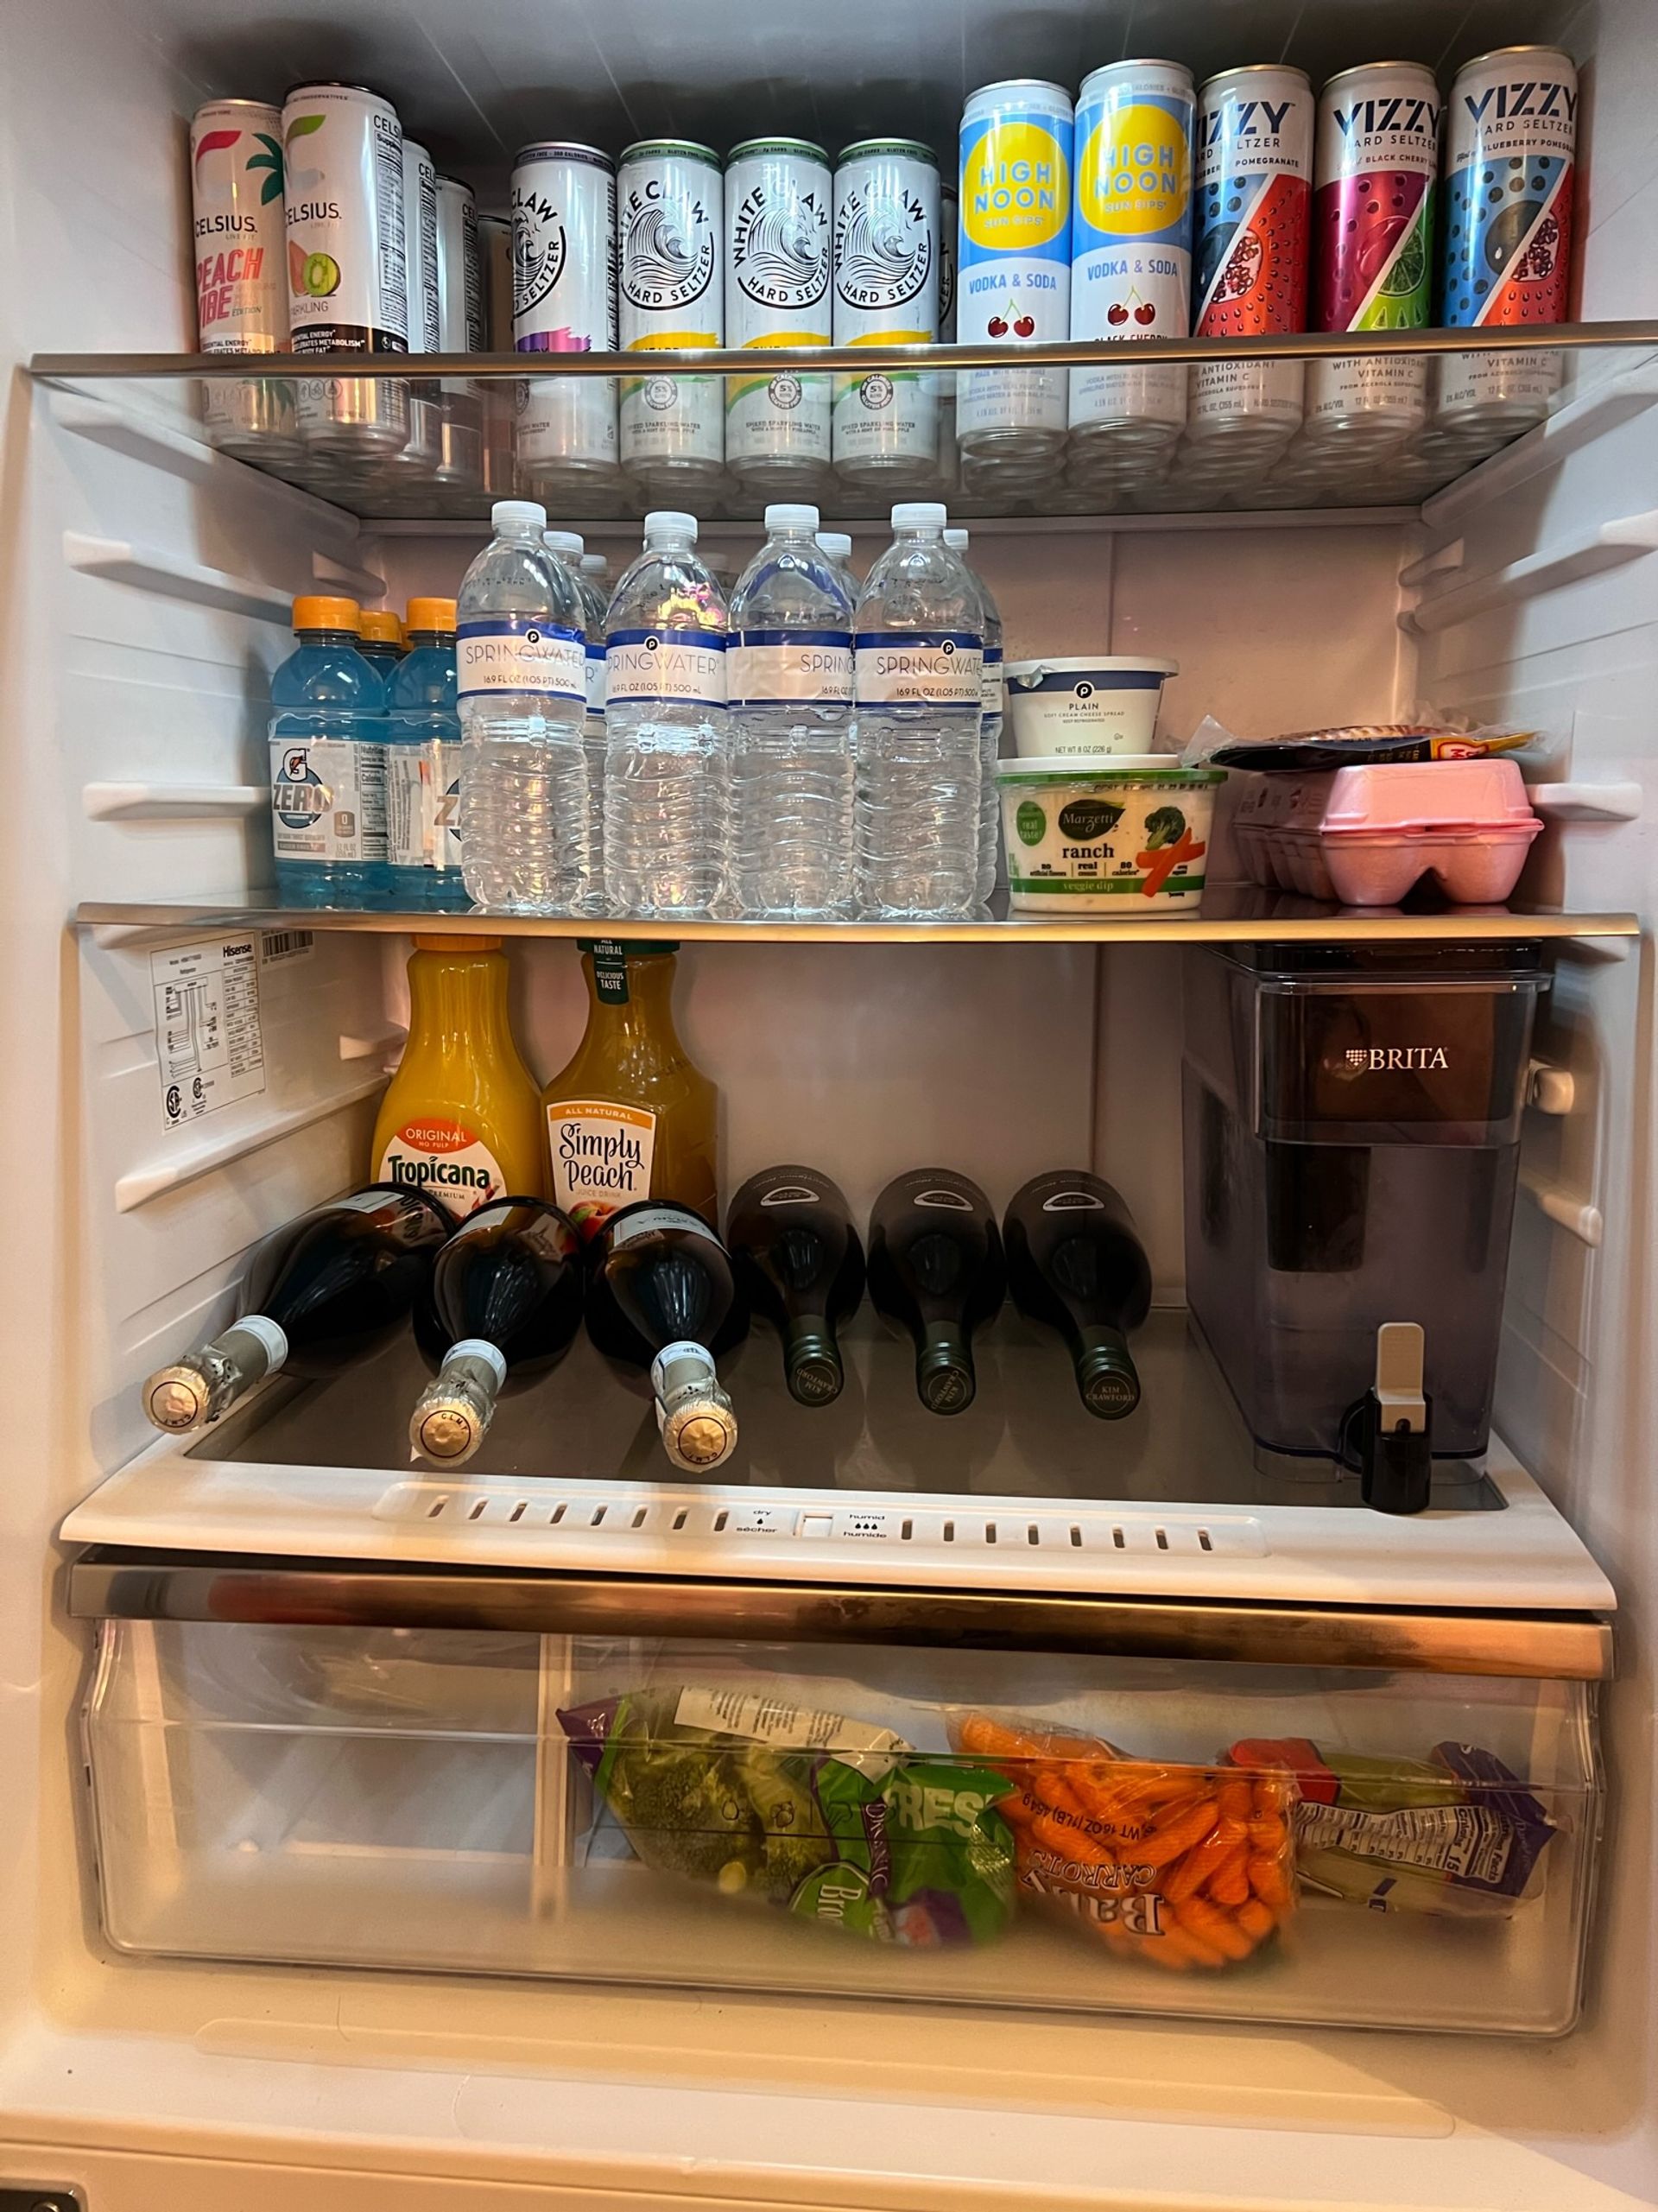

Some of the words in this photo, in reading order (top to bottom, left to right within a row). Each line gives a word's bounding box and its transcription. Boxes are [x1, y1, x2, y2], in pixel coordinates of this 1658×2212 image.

[1465, 82, 1577, 124] VIZZY
[1333, 98, 1440, 136] VIZZY
[1353, 135, 1383, 149] ARD
[1102, 143, 1174, 168] HIGH
[1235, 157, 1299, 168] POMEGRANATE
[1365, 154, 1396, 162] BLACK
[1399, 154, 1427, 163] CHERRY
[980, 162, 1052, 188] HIGH
[1094, 169, 1177, 198] NOON
[974, 187, 1055, 216] NOON
[733, 187, 766, 269] WHITE
[834, 190, 861, 275] WHITE
[522, 239, 560, 305] SELTZER
[627, 282, 663, 304] HARD
[670, 244, 712, 302] SELTZER
[747, 276, 789, 302] HARD
[795, 246, 828, 302] SELTZER
[843, 282, 880, 302] HARD
[887, 241, 927, 301] SELTZER
[1087, 260, 1128, 282] VODKA
[1134, 258, 1142, 274] &
[1149, 258, 1178, 277] SODA
[969, 274, 1007, 295] VODKA
[1012, 274, 1022, 288] &
[1026, 273, 1057, 291] SODA
[1201, 360, 1276, 377] ANTIOXIDANT
[1332, 359, 1362, 371] WITH
[1487, 357, 1537, 367] VITAMIN
[1541, 358, 1547, 366] C
[1196, 373, 1238, 389] VITAMIN
[1242, 372, 1250, 381] C
[1357, 369, 1405, 378] VITAMIN
[1408, 370, 1414, 378] C
[1468, 372, 1488, 381] FROM
[803, 421, 821, 431] WATER
[498, 675, 507, 684] FL
[509, 675, 522, 683] OZ
[555, 677, 571, 688] 500
[629, 682, 639, 691] OZ
[674, 684, 692, 693] 500
[912, 688, 921, 696] FL
[923, 688, 935, 697] OZ
[1068, 702, 1099, 711] PLAIN
[1055, 745, 1066, 754] NET
[1067, 745, 1077, 754] WT
[1082, 745, 1092, 753] OZ
[1062, 813, 1114, 833] Marzetti
[1062, 843, 1115, 859] ranch
[1063, 882, 1092, 891] veggie
[1097, 881, 1114, 891] dip
[222, 943, 252, 958] Hisense
[593, 944, 623, 955] NATURAL
[596, 970, 624, 980] DELICIOUS
[600, 979, 622, 990] TASTE
[1368, 1047, 1449, 1070] BRITA
[585, 1107, 634, 1121] NATURAL
[405, 1127, 467, 1143] ORIGINAL
[559, 1122, 645, 1170] Simply
[387, 1155, 490, 1189] Tropicana
[562, 1159, 635, 1192] Peach
[576, 1188, 597, 1197] JUICE
[796, 1367, 838, 1395] CRAWFORD
[805, 1381, 822, 1395] KIM
[946, 1385, 959, 1403] KIM
[1085, 1392, 1136, 1404] CRAWFORD
[1101, 1386, 1121, 1395] KIM
[736, 1525, 778, 1534] sécher
[843, 1531, 888, 1539] humide
[883, 1780, 994, 1838] RES
[1120, 1823, 1140, 1840] WT
[1026, 1849, 1157, 1892] CARROTS
[1446, 1855, 1463, 1872] 15
[1487, 1851, 1503, 1882] Facts
